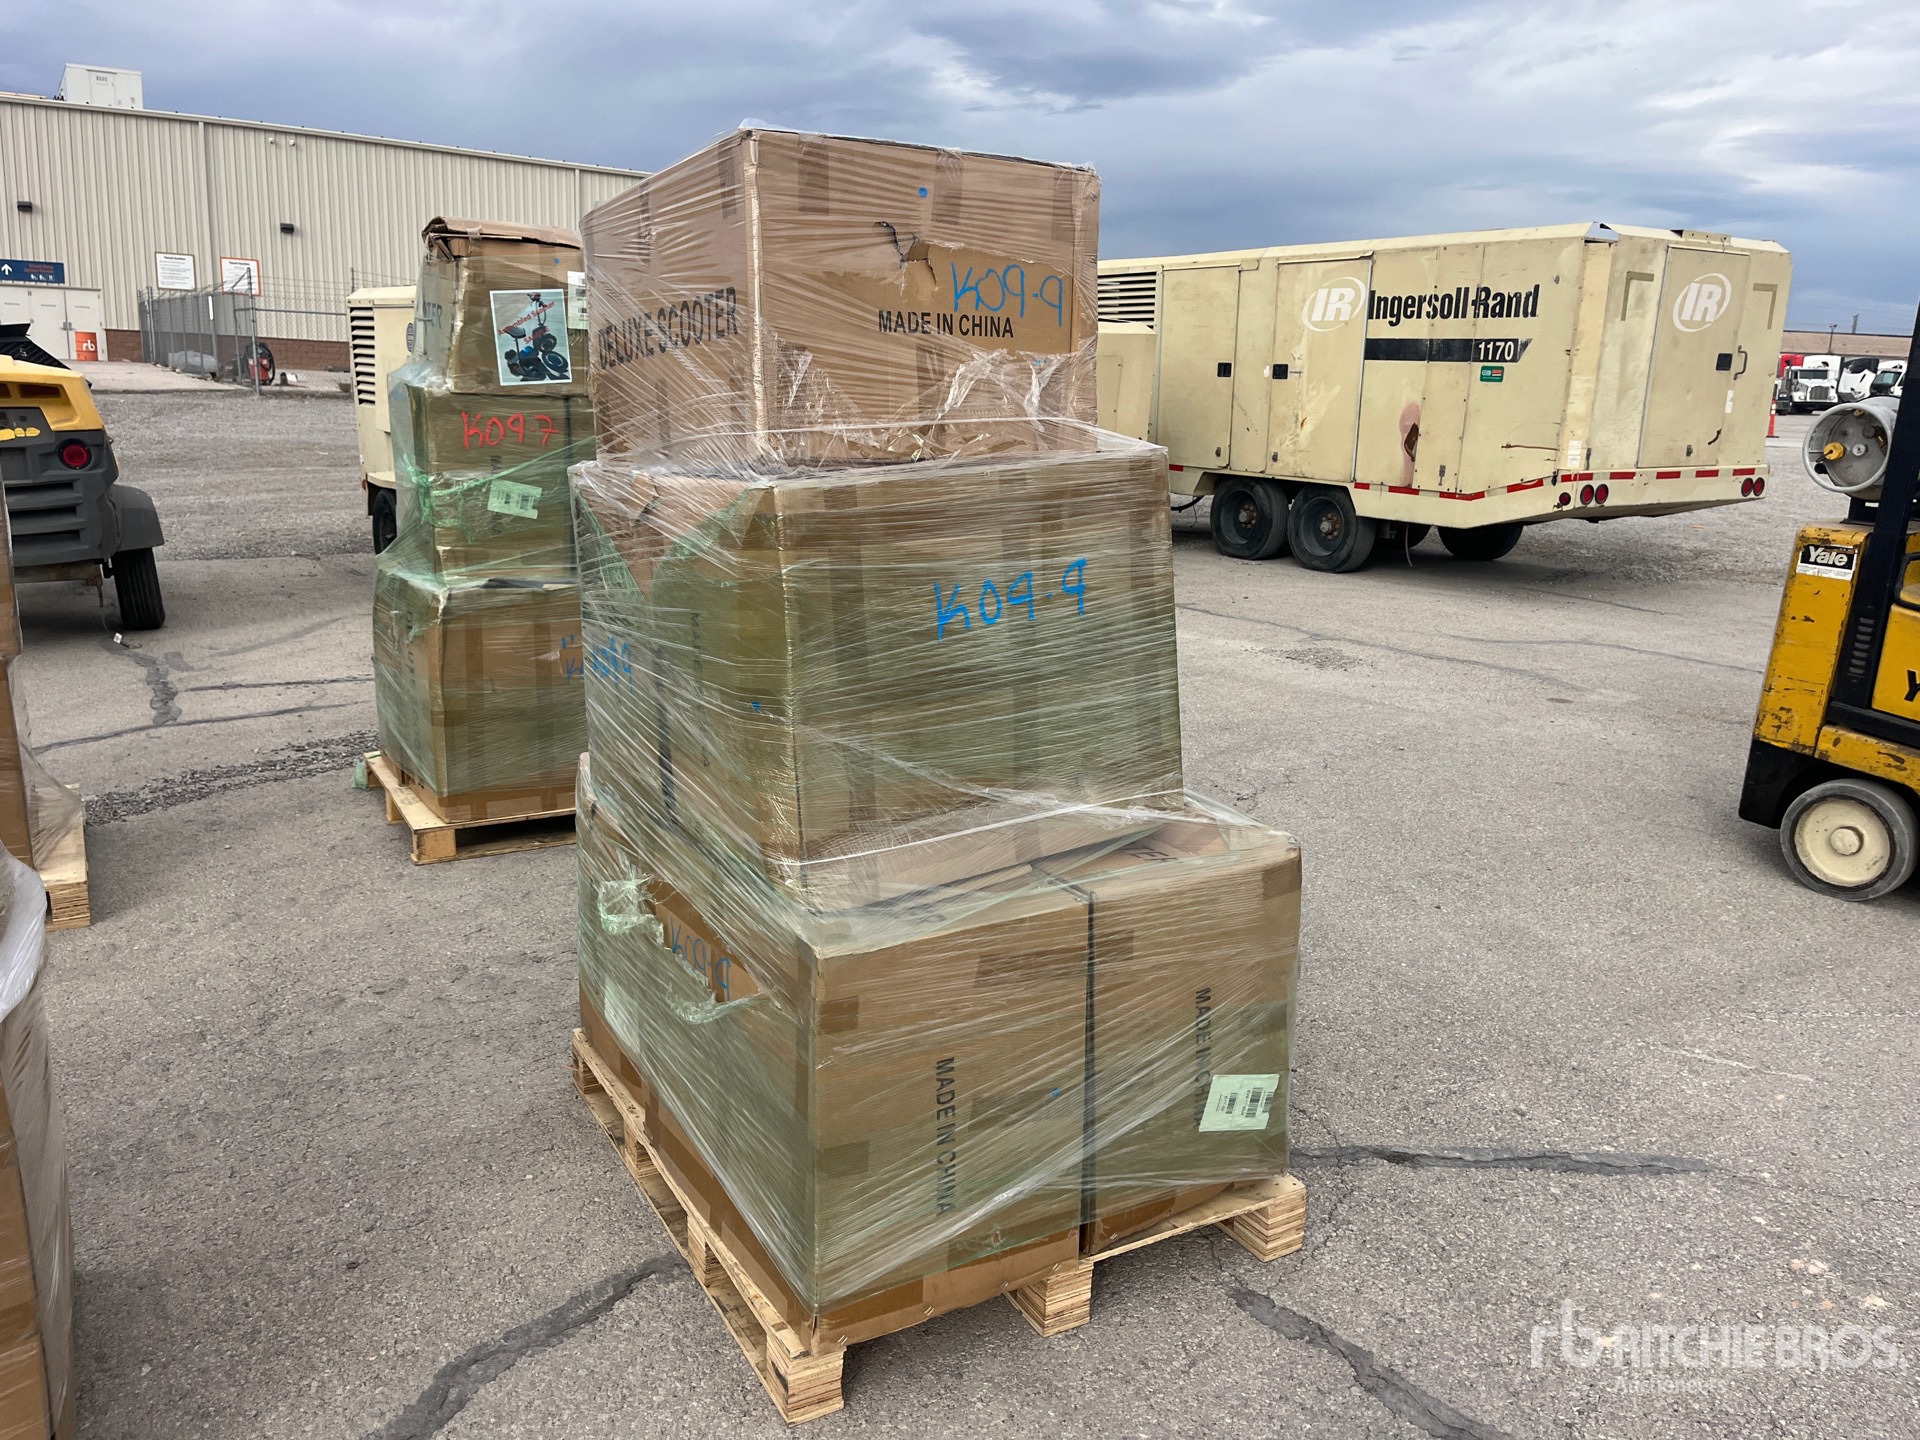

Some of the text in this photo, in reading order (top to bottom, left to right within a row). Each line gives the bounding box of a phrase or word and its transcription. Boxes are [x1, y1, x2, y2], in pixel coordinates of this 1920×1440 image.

[1311, 287, 1356, 323] IR
[1368, 283, 1539, 327] Ingersoll-Rand
[1681, 282, 1723, 322] IR
[598, 311, 655, 370] DELUXE
[657, 286, 738, 354] SCOOTER
[878, 309, 1014, 338] MADE IN CHINA
[1478, 341, 1515, 361] 1170
[1808, 545, 1848, 567] Yale
[1194, 987, 1212, 1043] MADE
[935, 1057, 957, 1217] MADE IN CHINA
